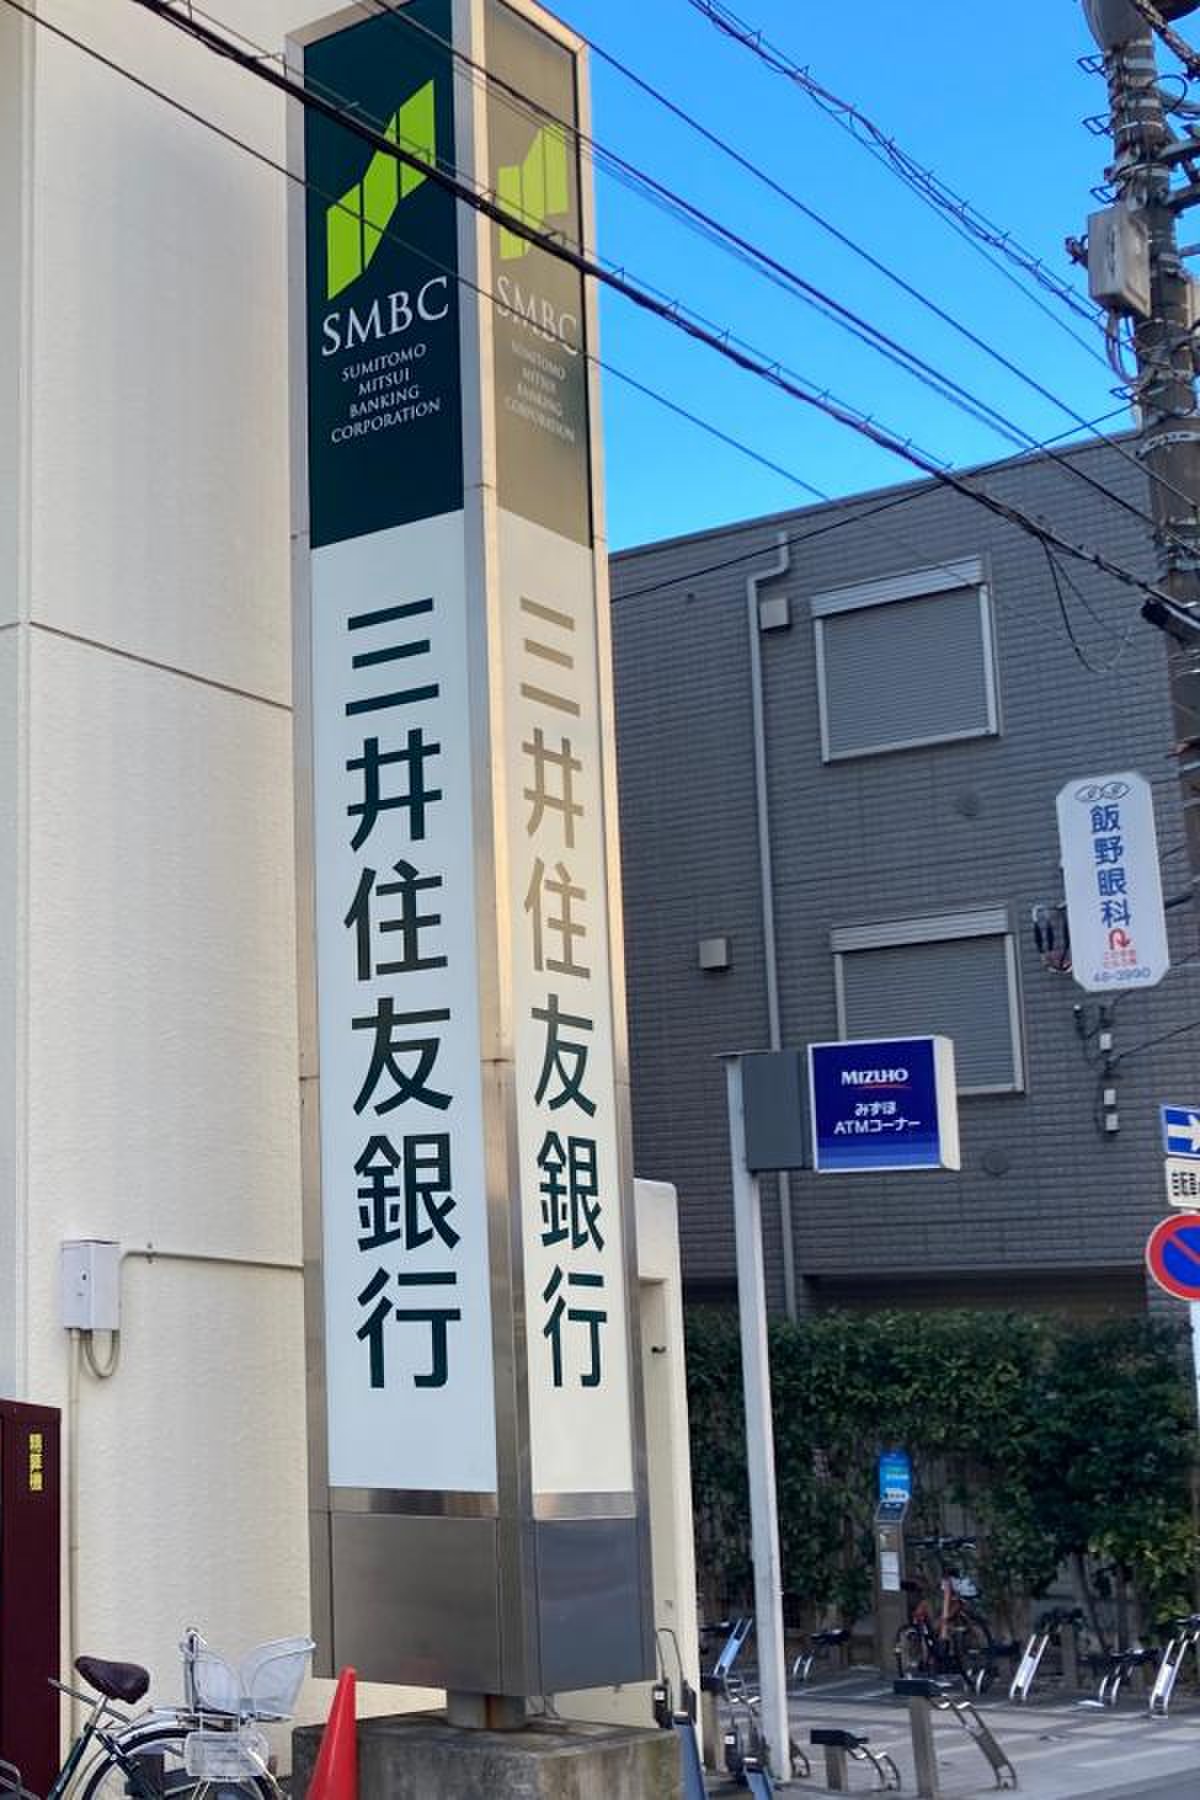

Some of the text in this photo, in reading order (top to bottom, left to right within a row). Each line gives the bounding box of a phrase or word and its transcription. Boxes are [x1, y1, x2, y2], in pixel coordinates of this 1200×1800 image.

[322, 276, 449, 356] SMBC
[496, 275, 578, 357] SMBC
[341, 343, 427, 382] SUMITOMO
[357, 367, 411, 396] MITSUI
[331, 398, 442, 444] CORPORATION
[349, 385, 420, 419] BANKING
[1089, 803, 1132, 928] 飯野眼科
[344, 598, 461, 1389] 三井住友銀行
[520, 596, 607, 1389] 三井住友銀行
[841, 1067, 909, 1086] MIZUHO
[833, 1117, 921, 1135] ATMコーナー
[854, 1101, 897, 1117] みずほ
